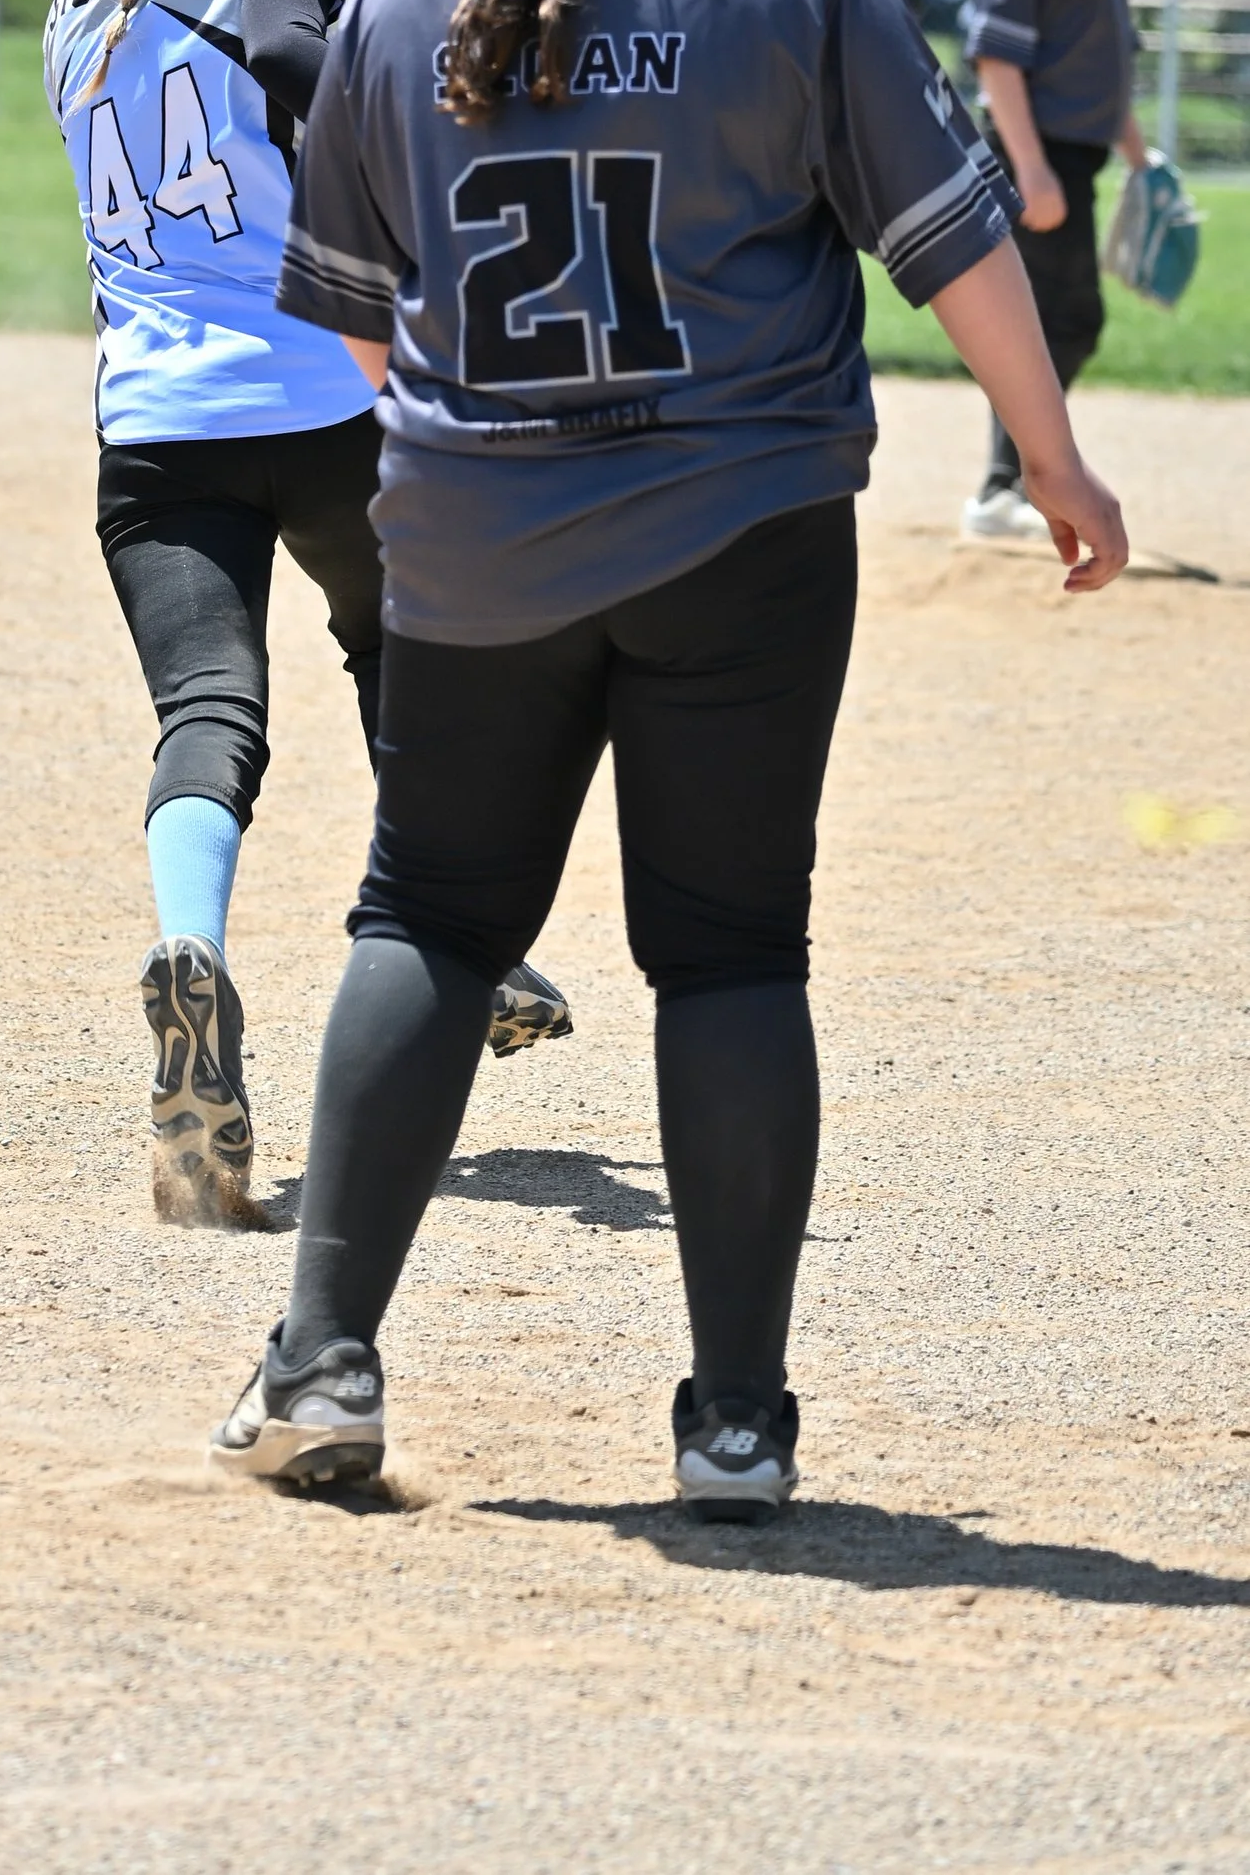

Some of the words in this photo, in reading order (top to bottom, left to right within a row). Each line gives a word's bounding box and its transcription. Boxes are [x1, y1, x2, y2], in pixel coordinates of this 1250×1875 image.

[432, 31, 686, 104] SAN
[88, 61, 244, 271] 44
[448, 149, 693, 391] 21
[705, 1426, 759, 1456] NB
